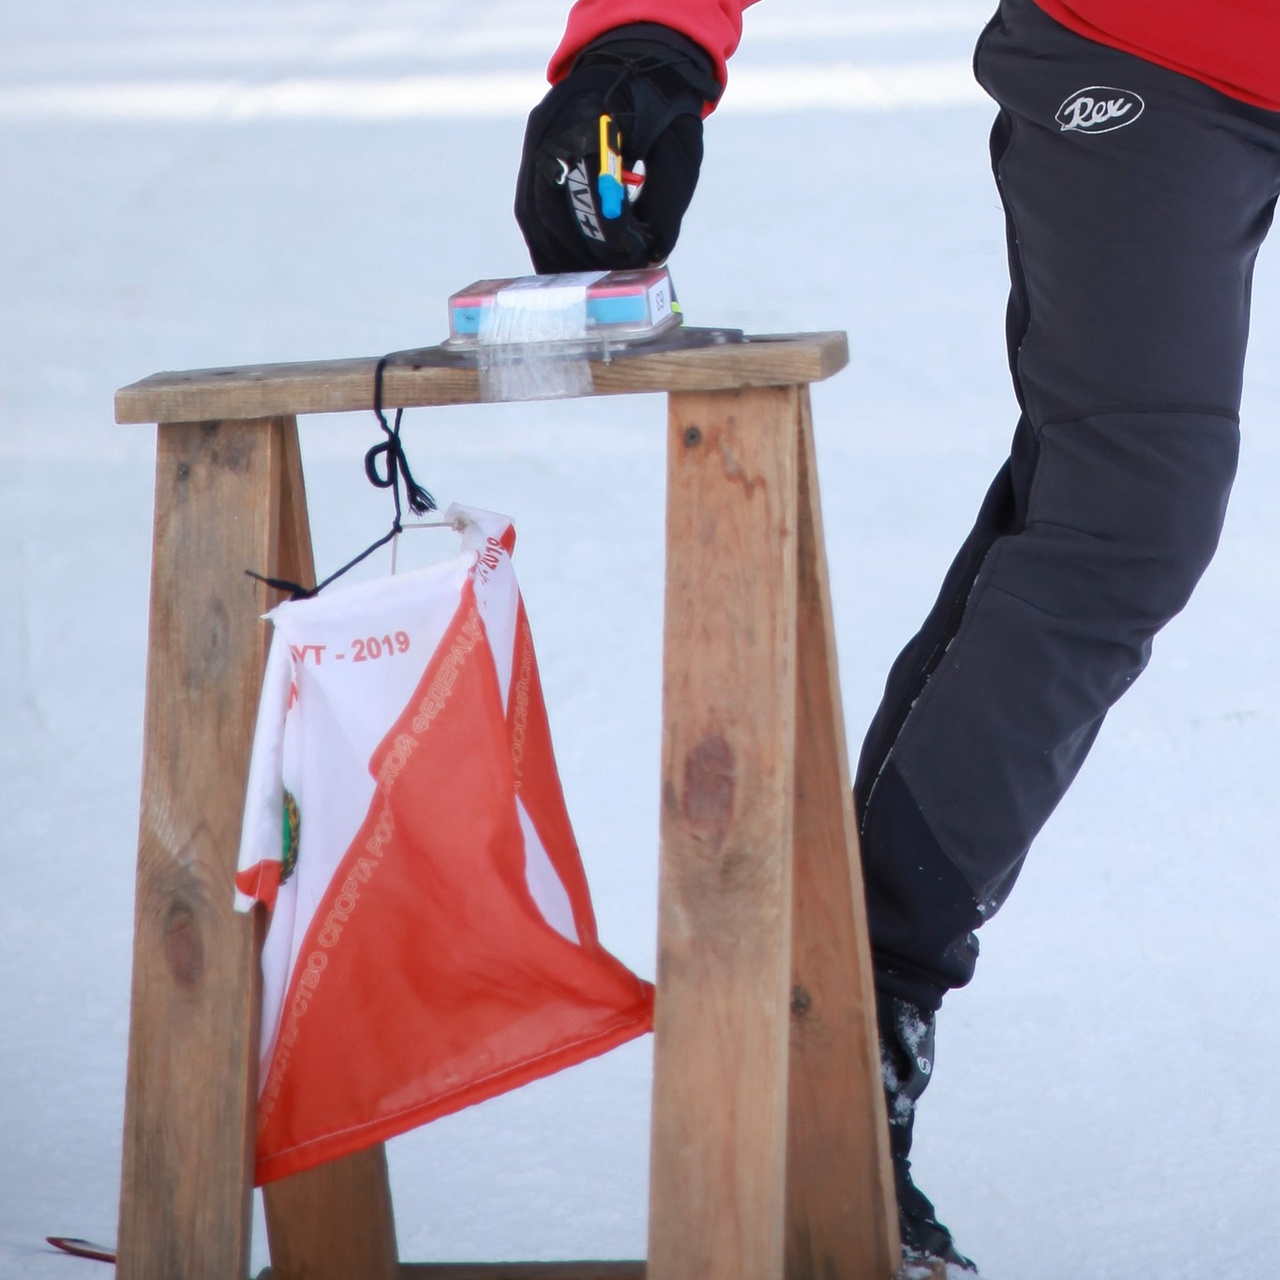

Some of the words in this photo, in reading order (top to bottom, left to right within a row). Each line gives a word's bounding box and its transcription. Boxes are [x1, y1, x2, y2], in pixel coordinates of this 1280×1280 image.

[1060, 96, 1133, 130] Rex
[351, 631, 411, 663] 2019
[318, 856, 378, 949] СПОРТА
